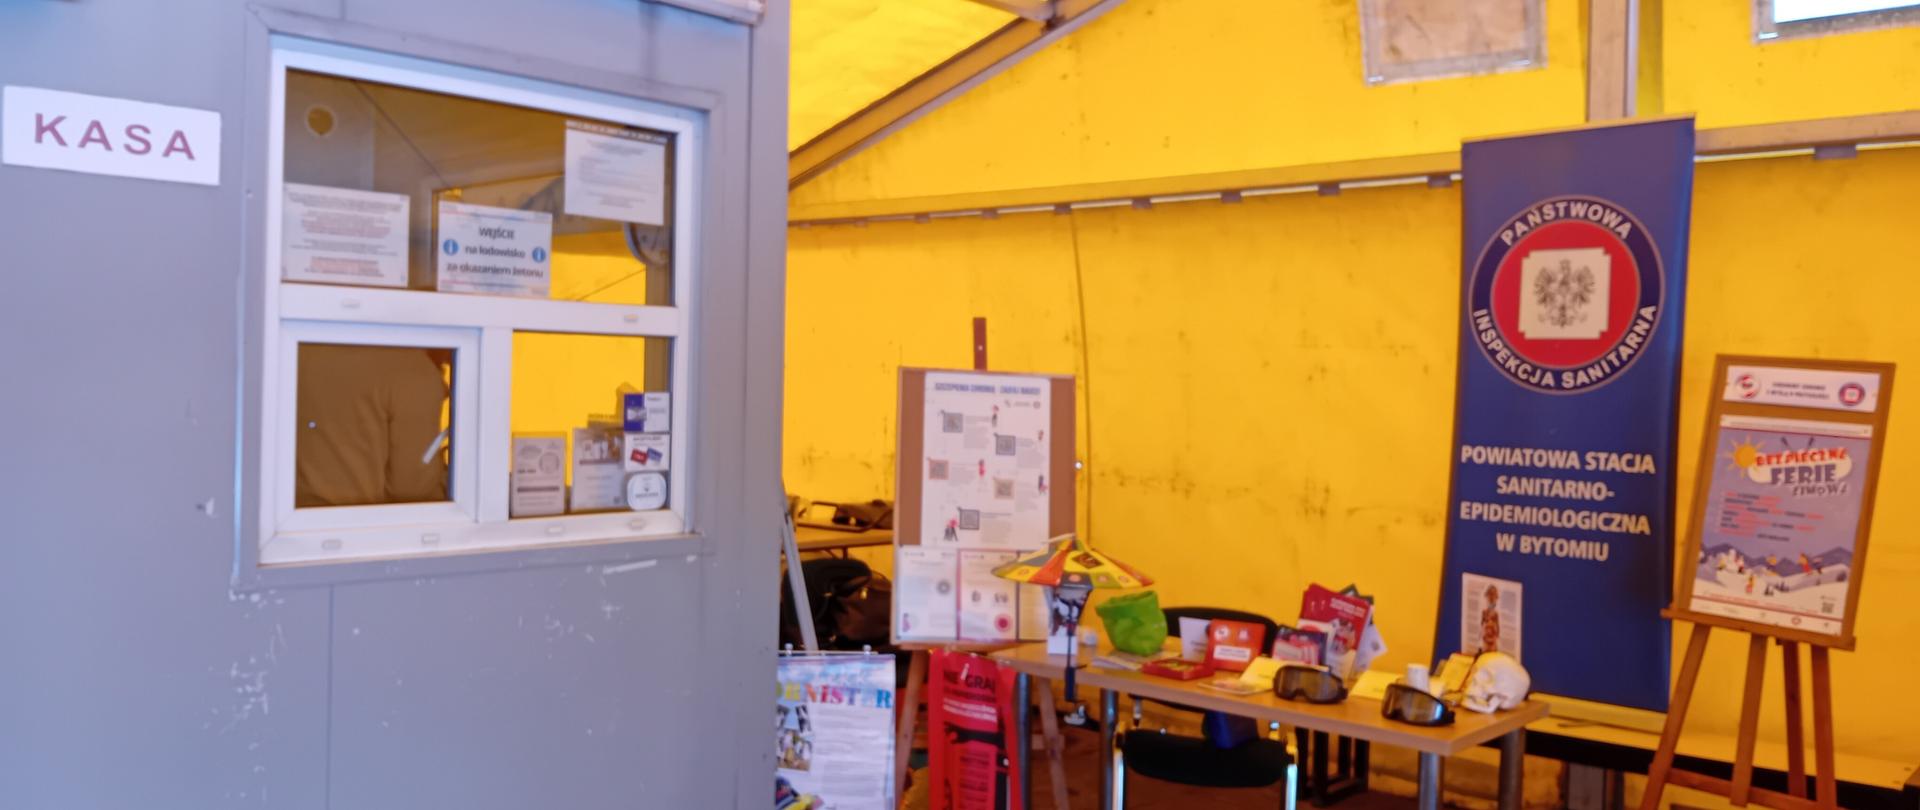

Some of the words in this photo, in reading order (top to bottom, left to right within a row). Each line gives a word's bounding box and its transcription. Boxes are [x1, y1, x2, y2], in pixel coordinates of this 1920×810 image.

[35, 113, 196, 160] KASA
[1501, 201, 1633, 246] PAŃSTWOWA
[1473, 308, 1556, 387] INSPEKCJA
[1561, 305, 1657, 389] SANITARNA
[1461, 445, 1580, 470] POWIATOWA
[1585, 451, 1656, 474] STACJA
[1770, 464, 1837, 485] FERIE
[1496, 475, 1615, 502] SANITARNO-
[1460, 501, 1650, 535] EPIDEMIOLOGICZNA
[1496, 533, 1515, 552] W
[1519, 535, 1610, 562] BYTOMIU
